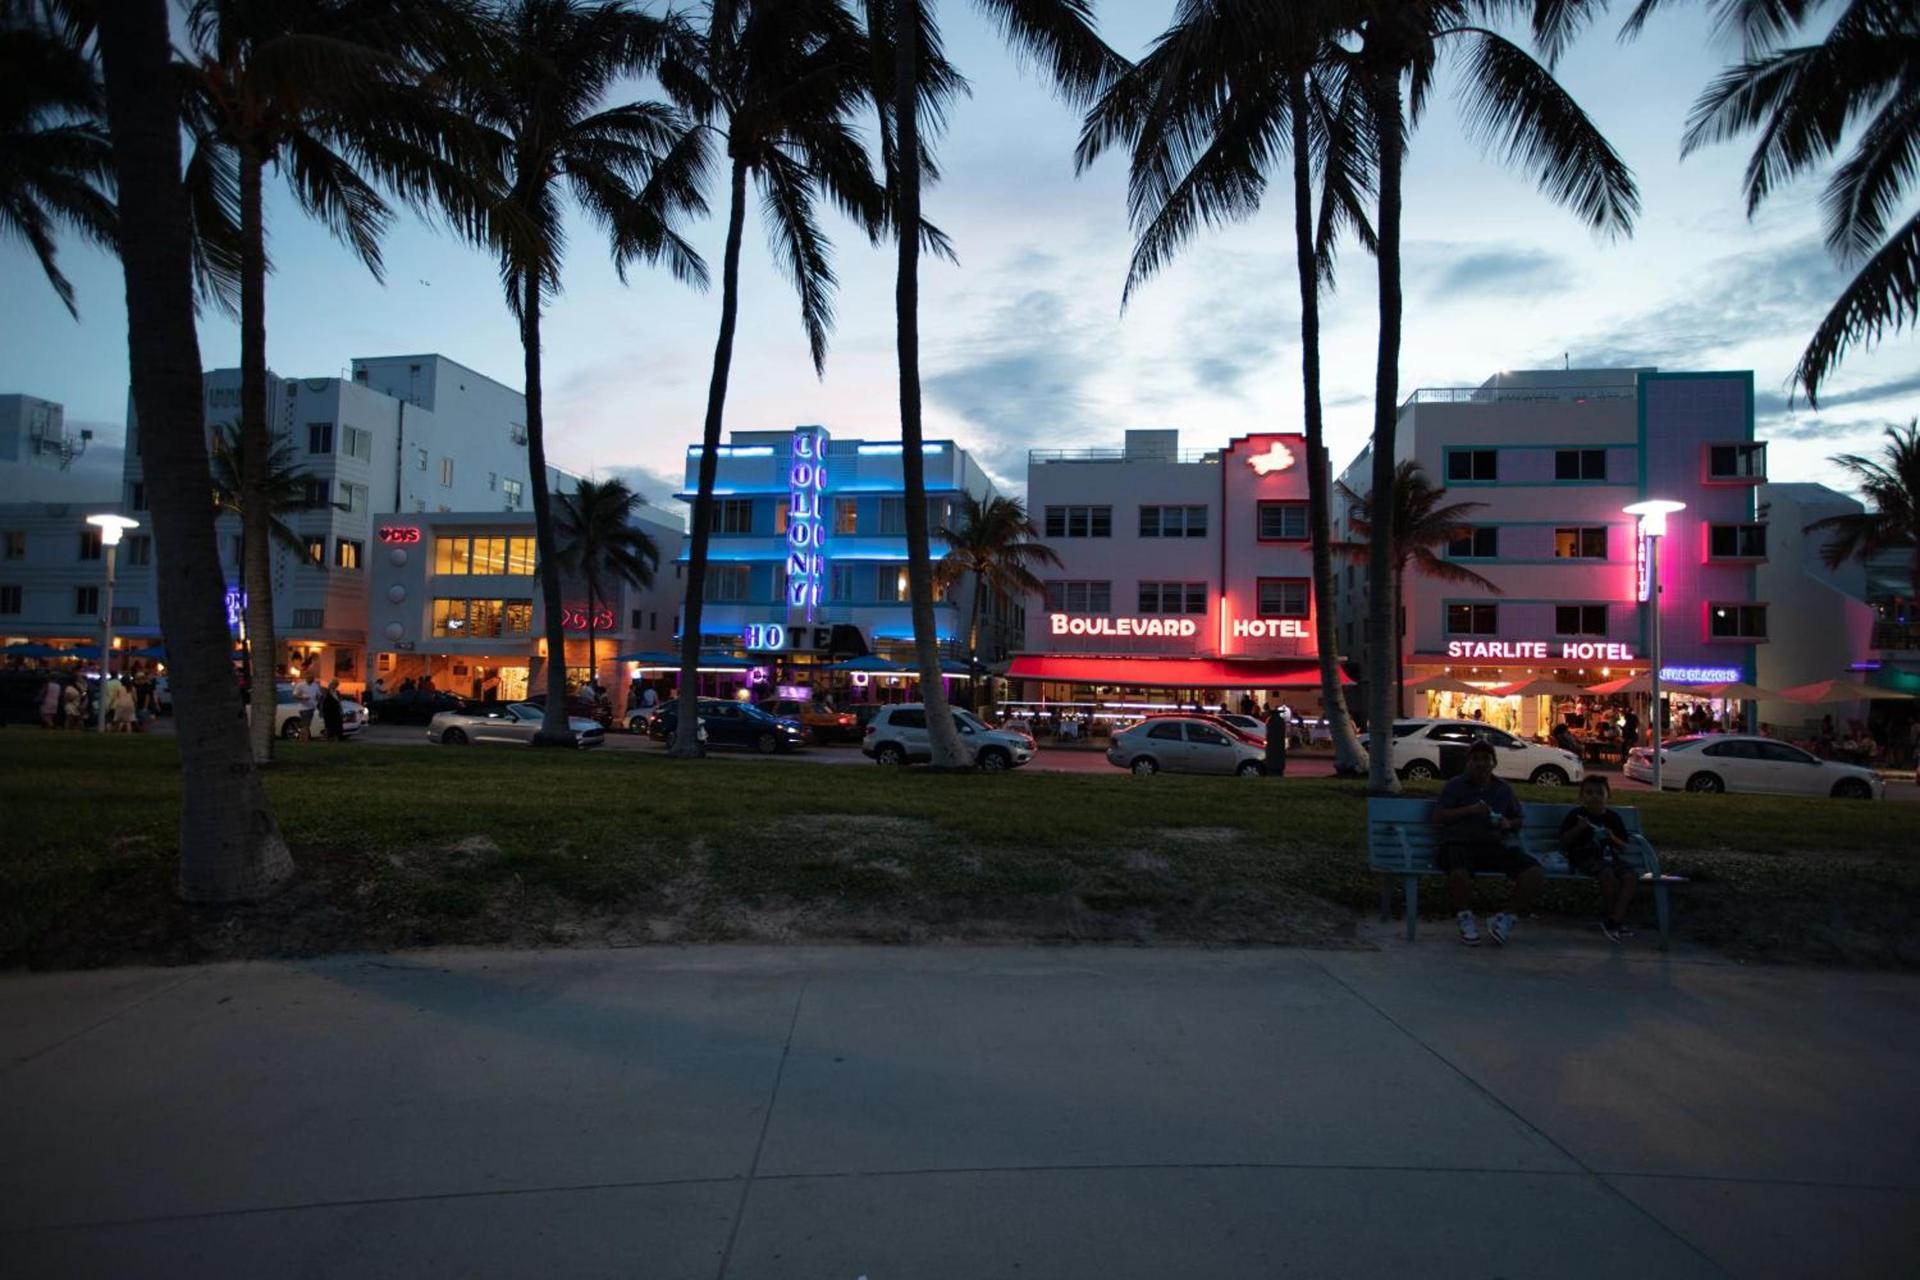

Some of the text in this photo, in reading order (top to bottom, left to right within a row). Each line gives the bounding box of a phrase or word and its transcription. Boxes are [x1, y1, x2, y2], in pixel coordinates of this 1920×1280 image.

[788, 434, 812, 606] COLONY
[391, 528, 420, 543] CVS
[745, 624, 833, 650] HOTE
[1050, 614, 1309, 638] BOULEVARD HOTEL
[1448, 641, 1633, 660] STARLITE HOTEL
